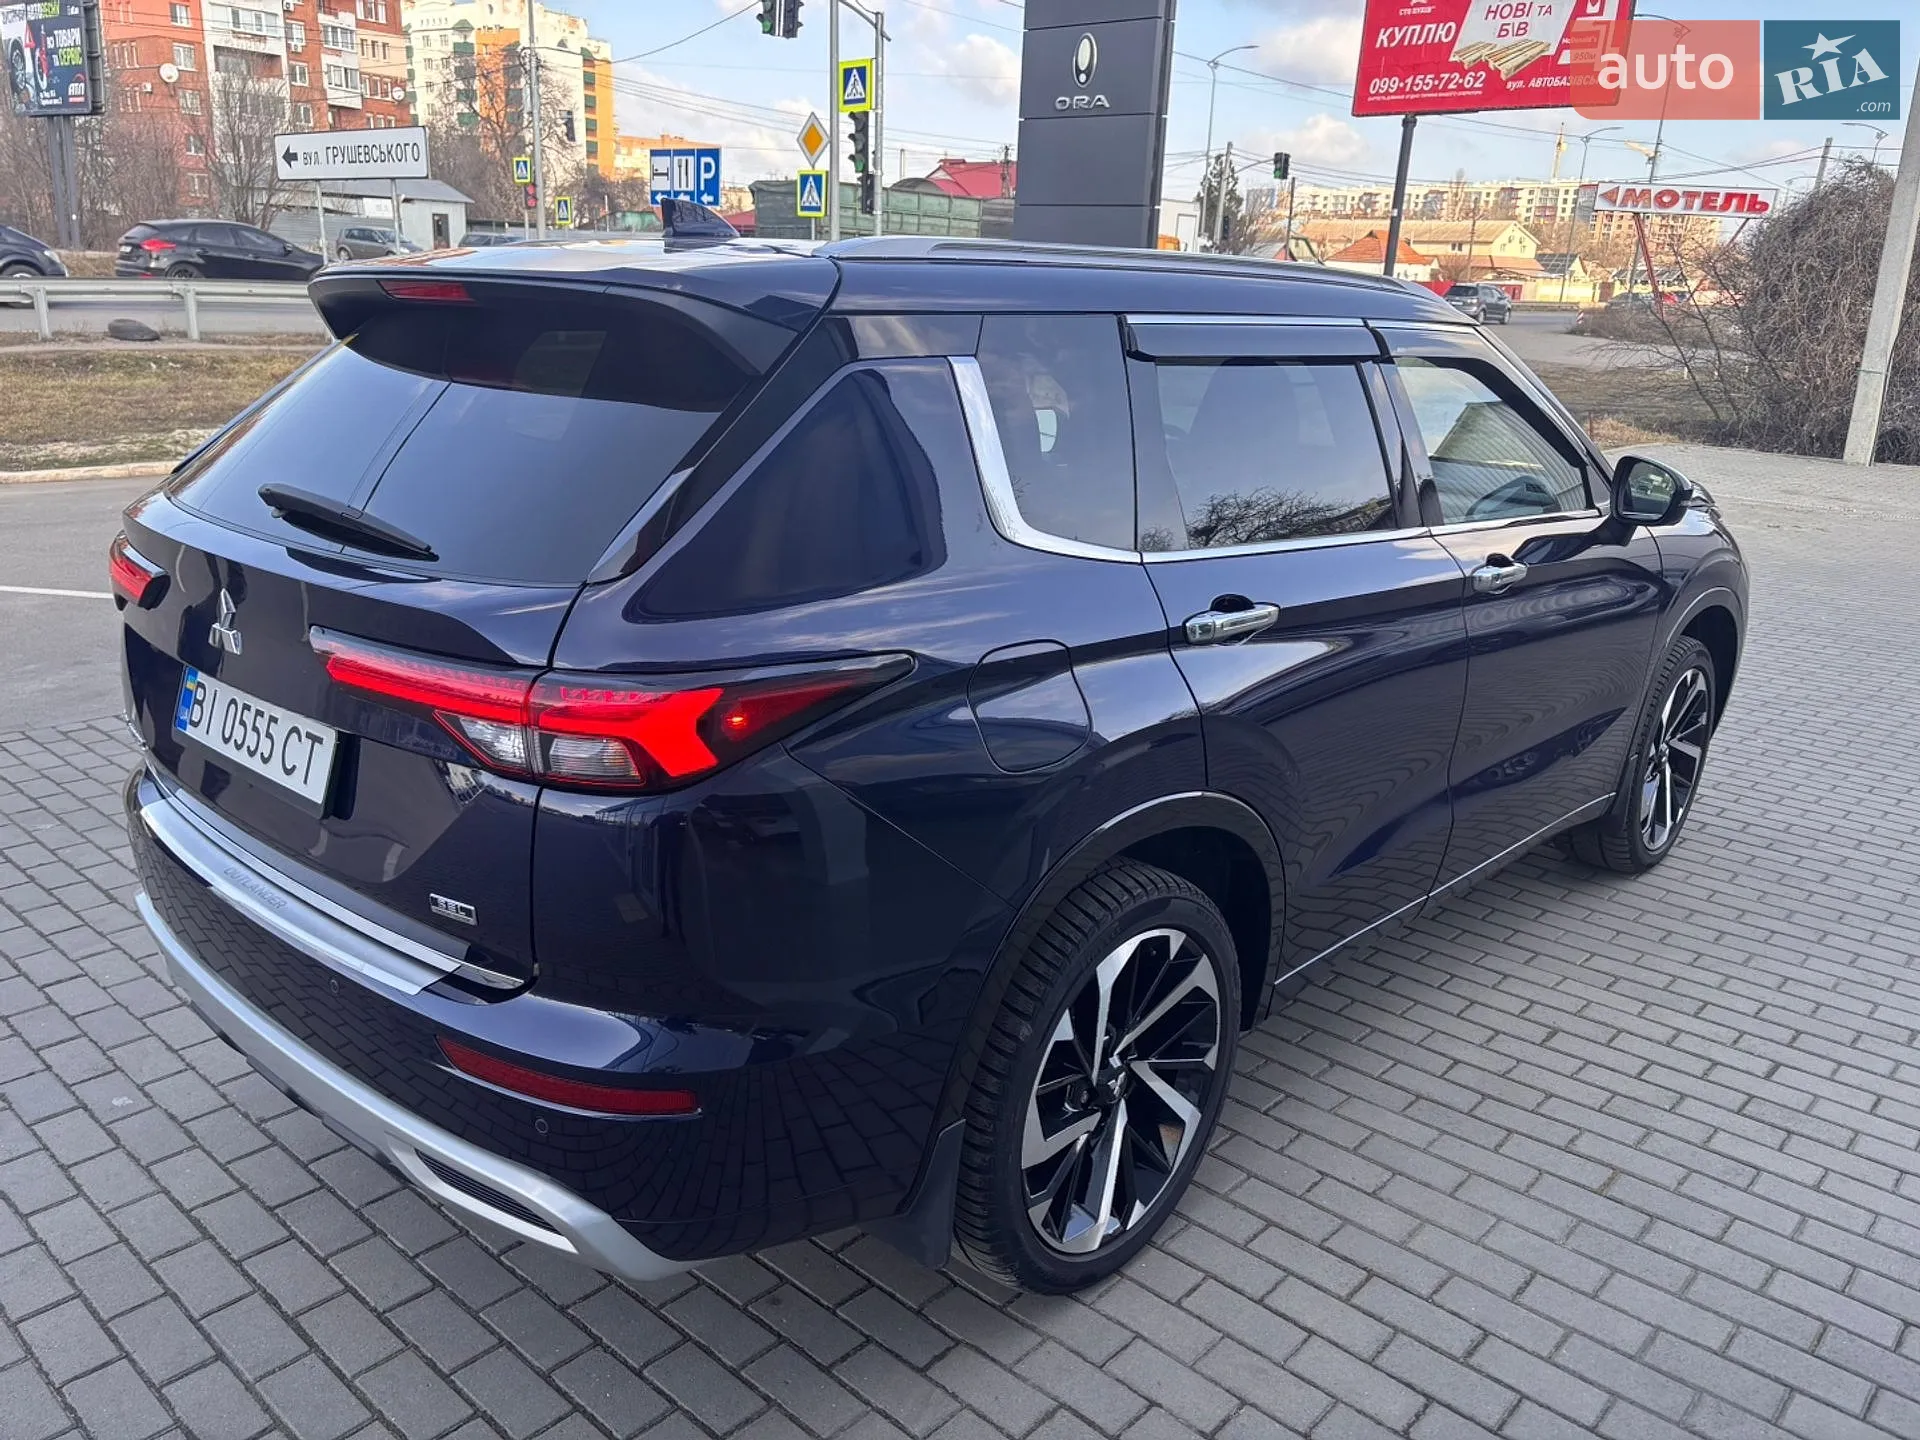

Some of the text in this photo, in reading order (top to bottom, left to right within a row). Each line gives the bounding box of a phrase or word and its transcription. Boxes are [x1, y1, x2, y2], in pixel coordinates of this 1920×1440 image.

[1484, 1, 1552, 21] НОВІ ТА
[54, 27, 81, 48] ТОВАРИ
[1375, 21, 1457, 49] КУПЛЮ
[1506, 79, 1526, 91] вул.
[1055, 94, 1110, 110] ORA
[326, 142, 420, 165] ГРУШЕВСЬКОГО
[1618, 187, 1770, 215] МОТЕЛЬ
[189, 680, 325, 786] BI 0555 CT
[223, 866, 288, 910] OUTLANDER
[437, 898, 466, 916] SEL
